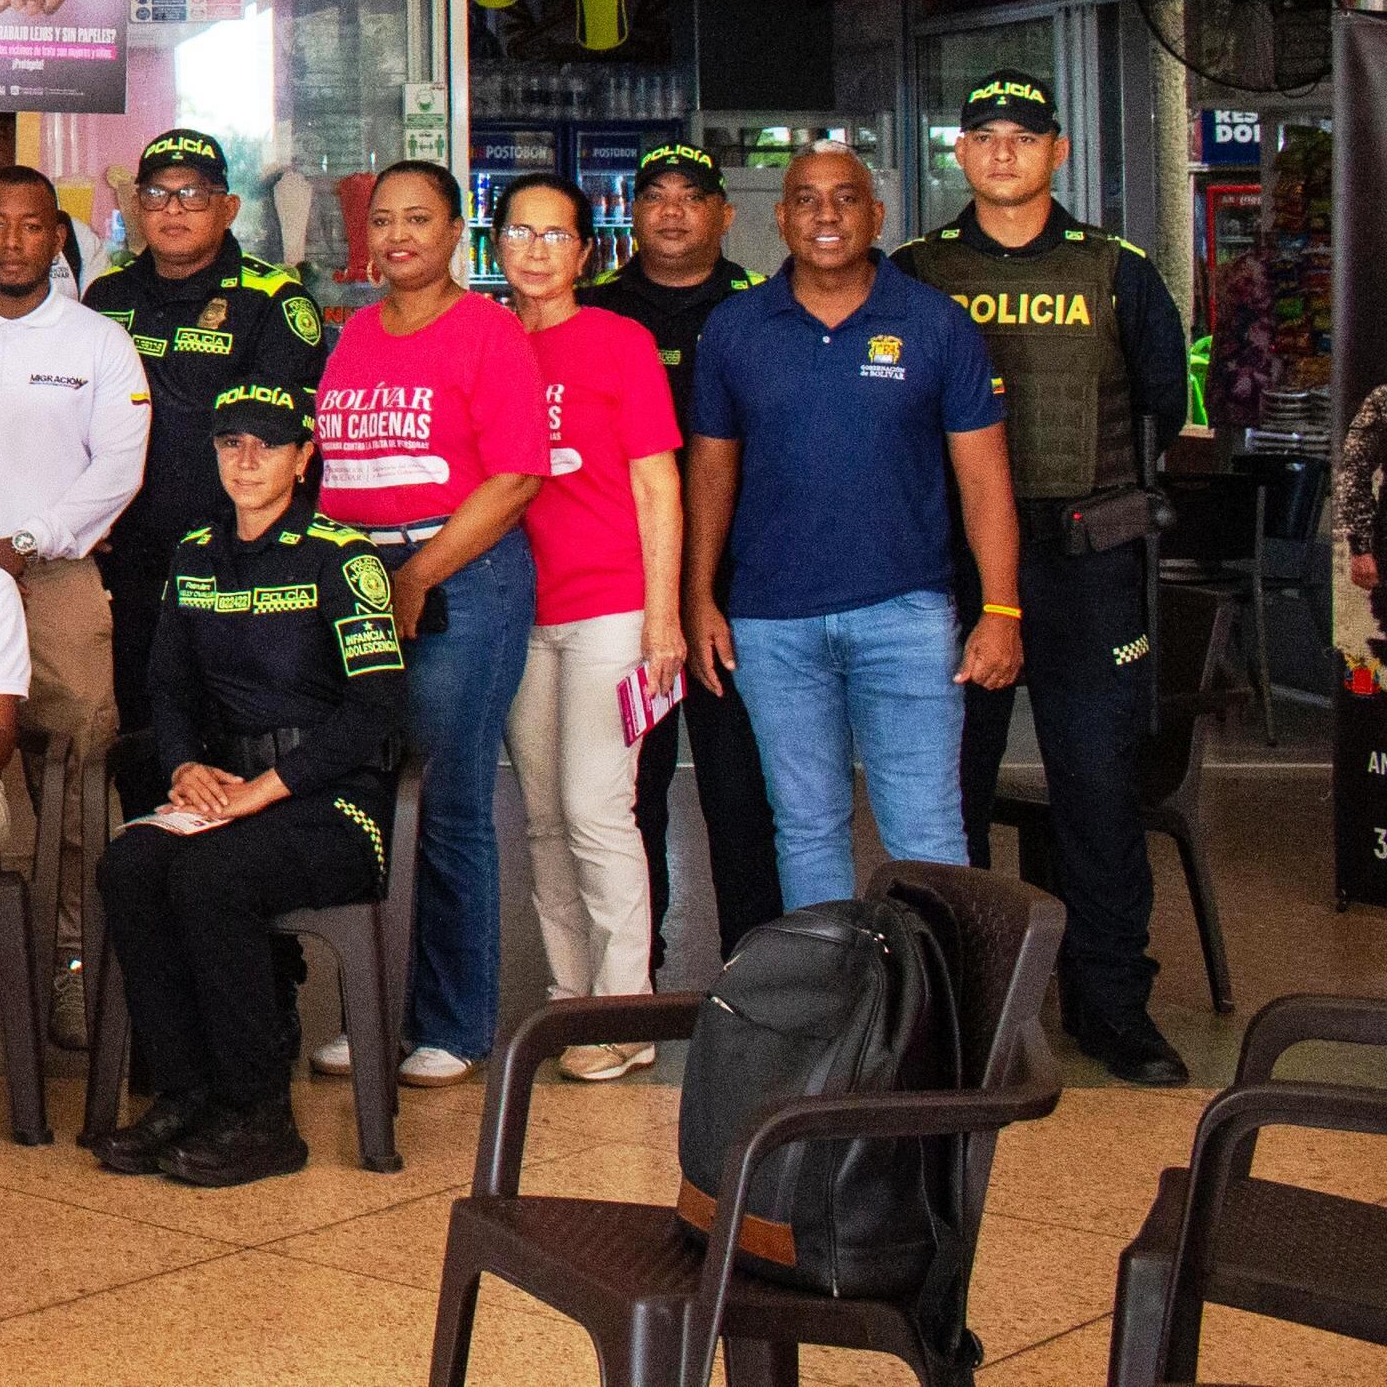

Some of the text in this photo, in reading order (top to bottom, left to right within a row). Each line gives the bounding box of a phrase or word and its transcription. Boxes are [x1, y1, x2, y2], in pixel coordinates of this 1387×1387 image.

[968, 80, 1047, 106] POLICÍA
[144, 138, 217, 159] POLICÍA
[215, 385, 294, 410] POLICÍA
[320, 381, 434, 412] BOLÍVAR
[318, 411, 431, 439] SIN CADENAS
[261, 589, 309, 602] POLICÍA
[346, 629, 385, 645] INFANCIA
[345, 640, 397, 659] ADOLESCENCIA
